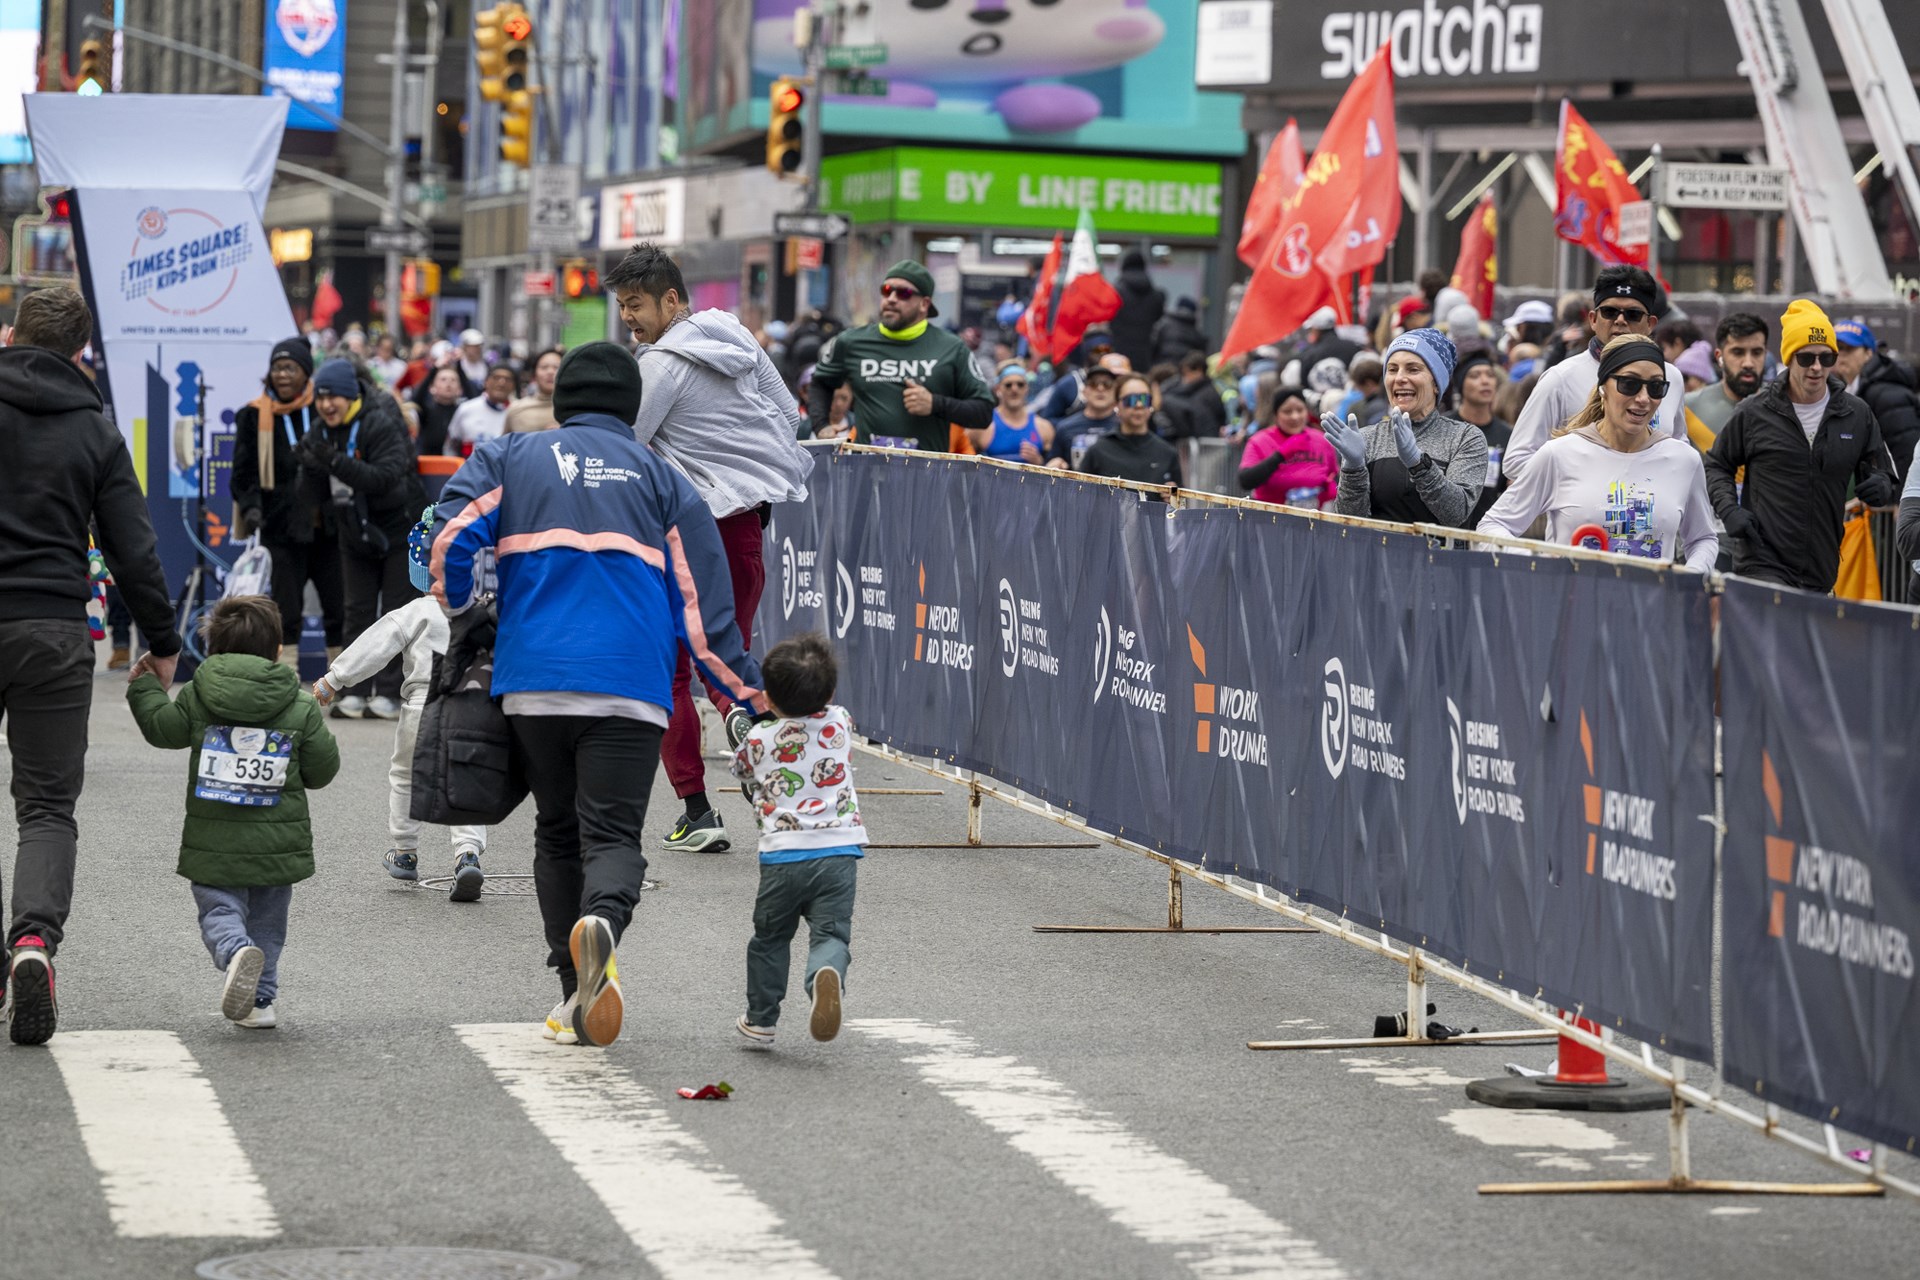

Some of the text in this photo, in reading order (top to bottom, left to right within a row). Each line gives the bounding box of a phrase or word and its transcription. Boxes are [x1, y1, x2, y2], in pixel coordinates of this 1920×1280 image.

[1321, 0, 1505, 78] swatch
[1675, 168, 1784, 185] PEDESTRIAN FLOW ZONE
[945, 170, 993, 203] BY
[1018, 173, 1098, 209] LINE
[1724, 190, 1784, 200] KEEP MOVING
[537, 198, 571, 224] 25
[128, 225, 242, 280] TIMES SQUARE
[157, 256, 218, 290] KIDS RUN
[121, 326, 248, 335] UNITED AIRLINES NYC HALF
[860, 359, 938, 377] DSNY
[585, 456, 604, 467] tcs
[604, 467, 625, 475] YORK
[625, 469, 642, 480] CITY
[583, 474, 628, 482] MARATHON
[583, 480, 600, 488] 2025
[1021, 647, 1039, 668] ROAD
[1466, 720, 1499, 750] RISING
[235, 757, 274, 781] 535
[1467, 753, 1516, 786] NEW YORK
[1468, 786, 1496, 814] ROAD
[1796, 844, 1833, 893] NEW
[1797, 900, 1915, 979] ROAD RUNNERS
